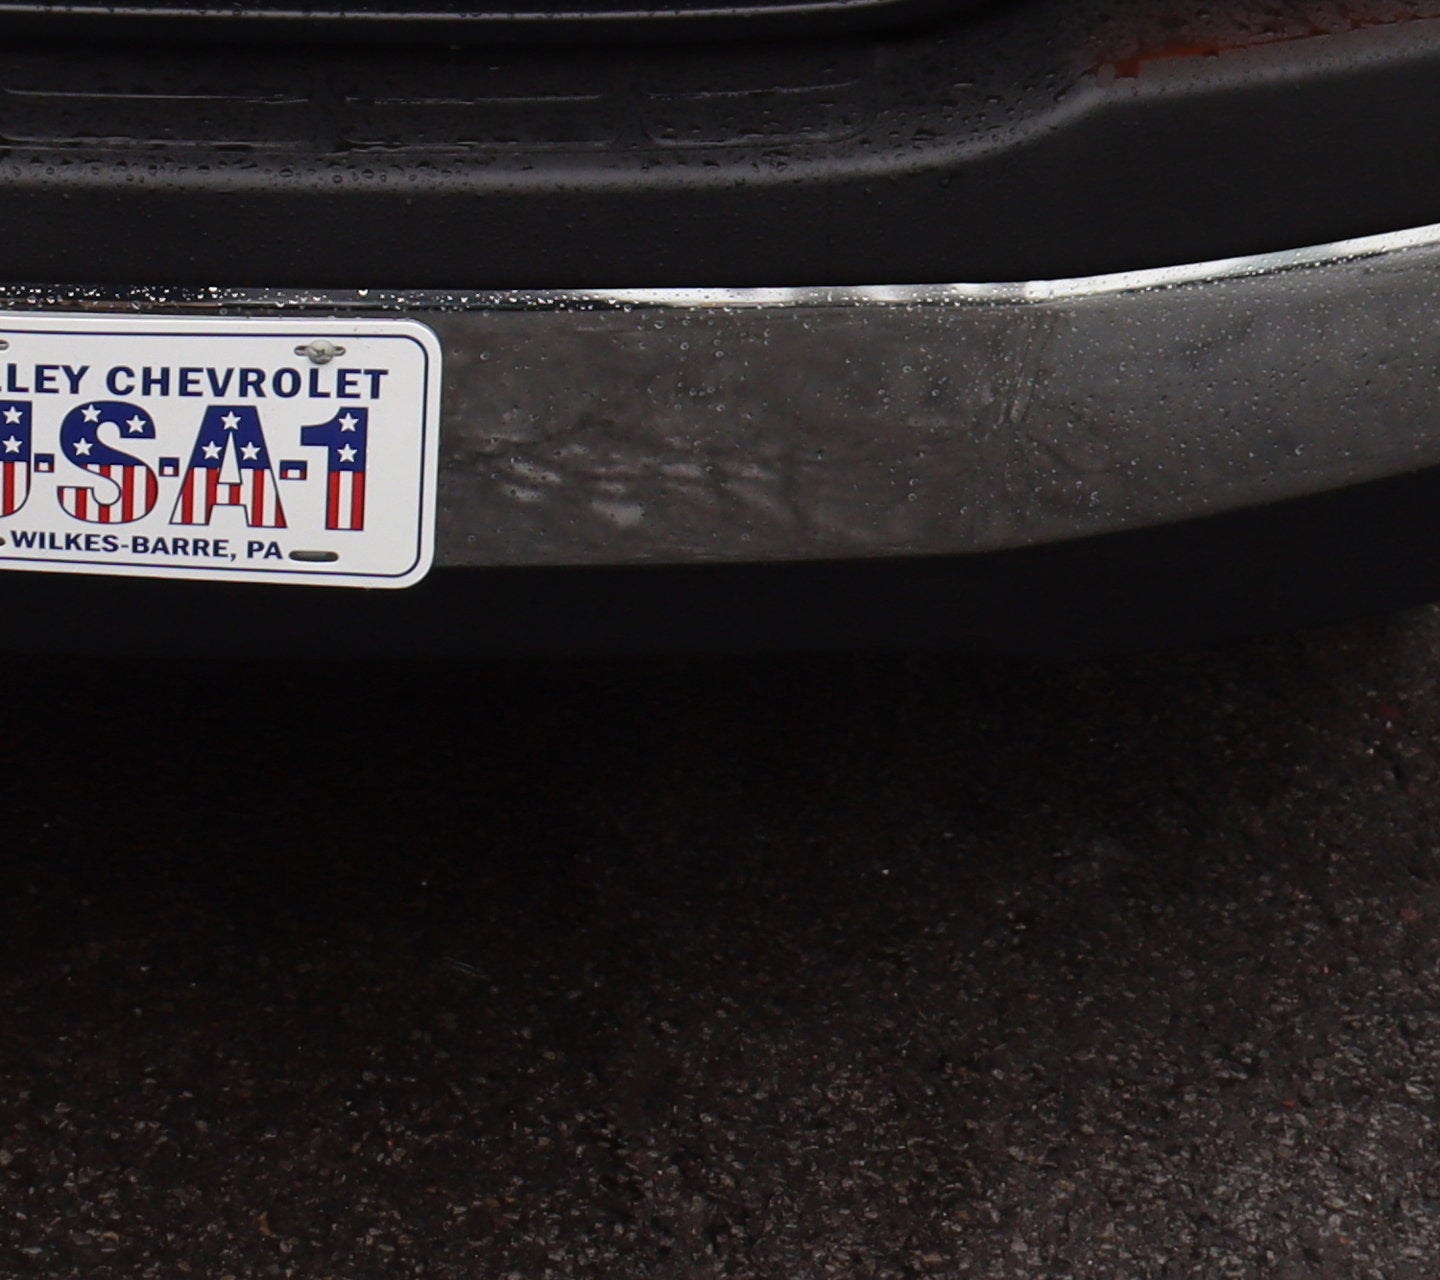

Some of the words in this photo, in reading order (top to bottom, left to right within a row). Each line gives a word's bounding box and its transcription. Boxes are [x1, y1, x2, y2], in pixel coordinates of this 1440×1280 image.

[105, 365, 389, 400] CHEVROLET
[10, 529, 237, 561] WILKES-BARRE,
[246, 540, 283, 560] PA
